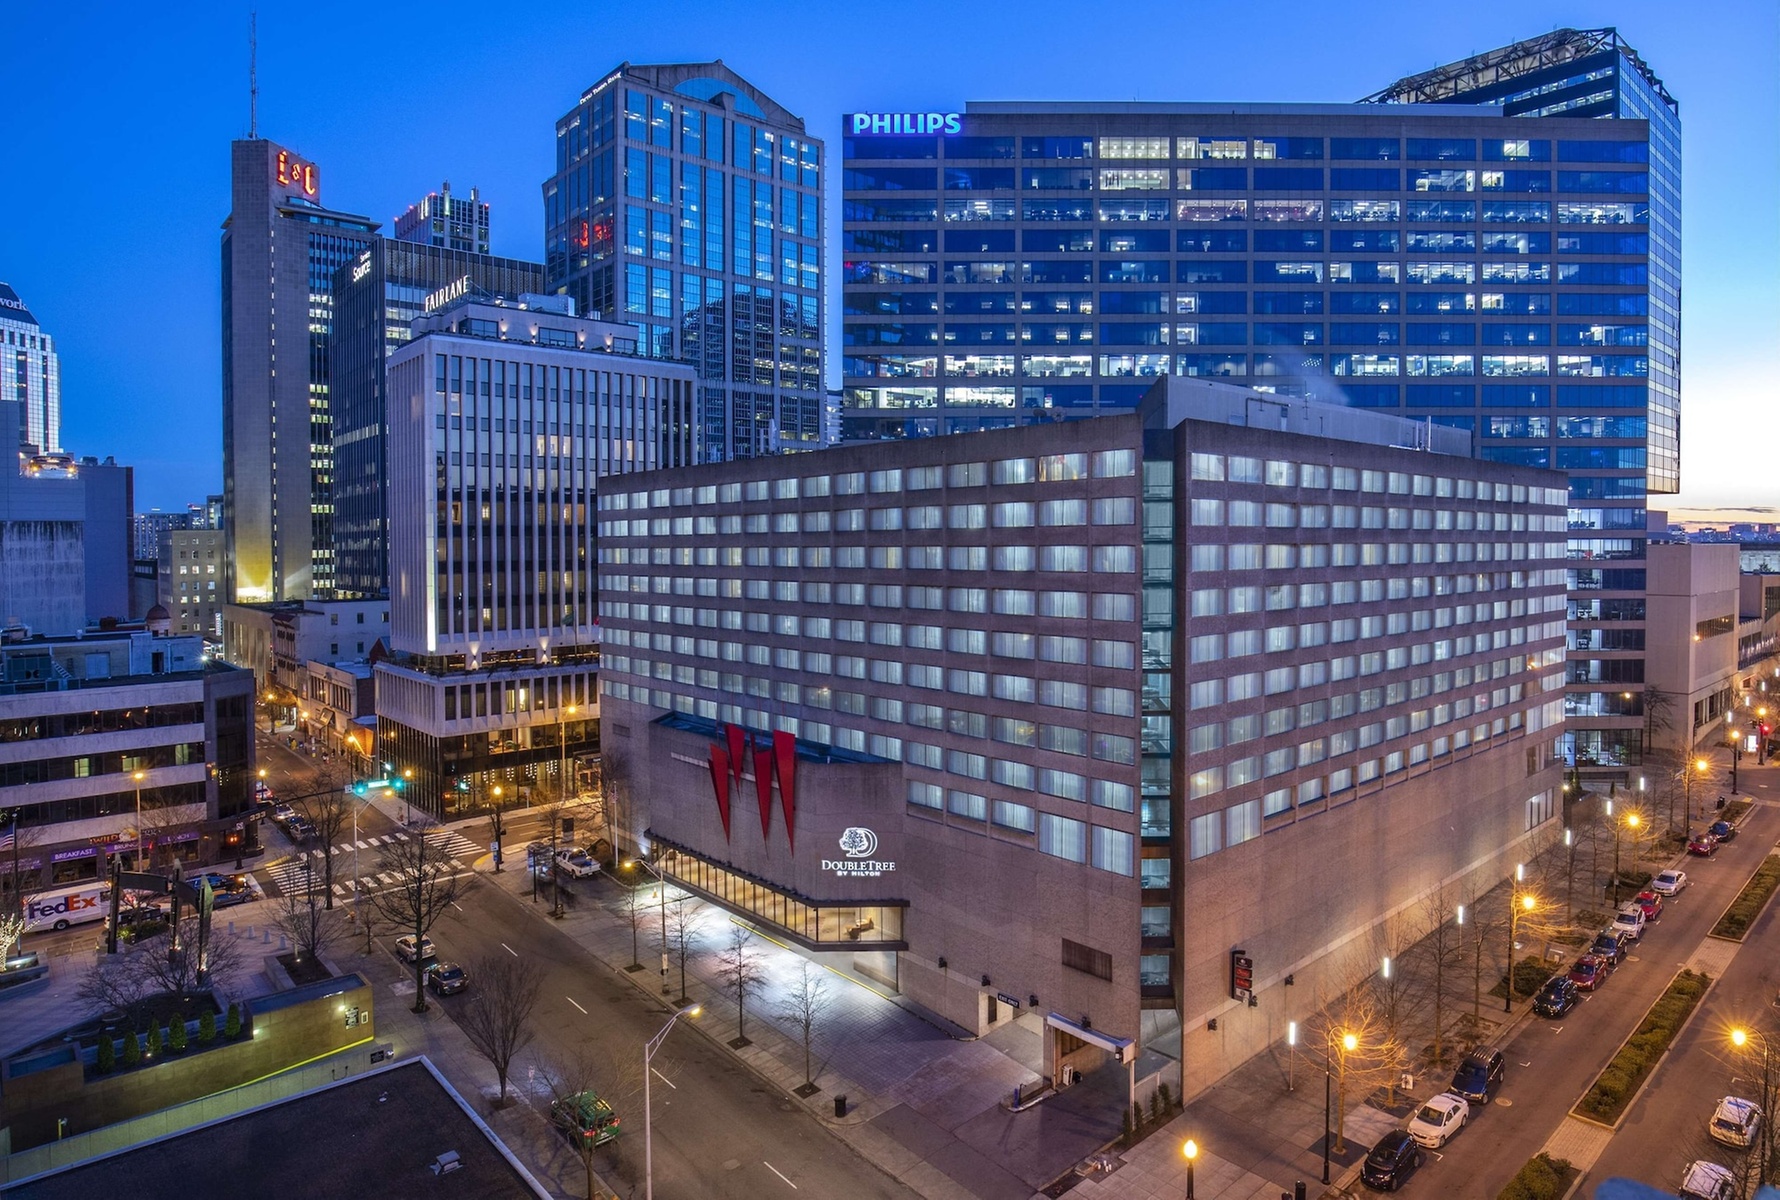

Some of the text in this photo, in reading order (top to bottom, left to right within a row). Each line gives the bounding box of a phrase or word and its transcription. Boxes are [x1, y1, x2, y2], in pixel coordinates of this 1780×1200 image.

[853, 113, 961, 134] PHILIPS
[353, 260, 371, 282] Source
[425, 275, 470, 313] FAIRLANE
[250, 811, 266, 821] 333
[54, 849, 93, 860] BREAKFAST
[28, 894, 97, 919] FedEx
